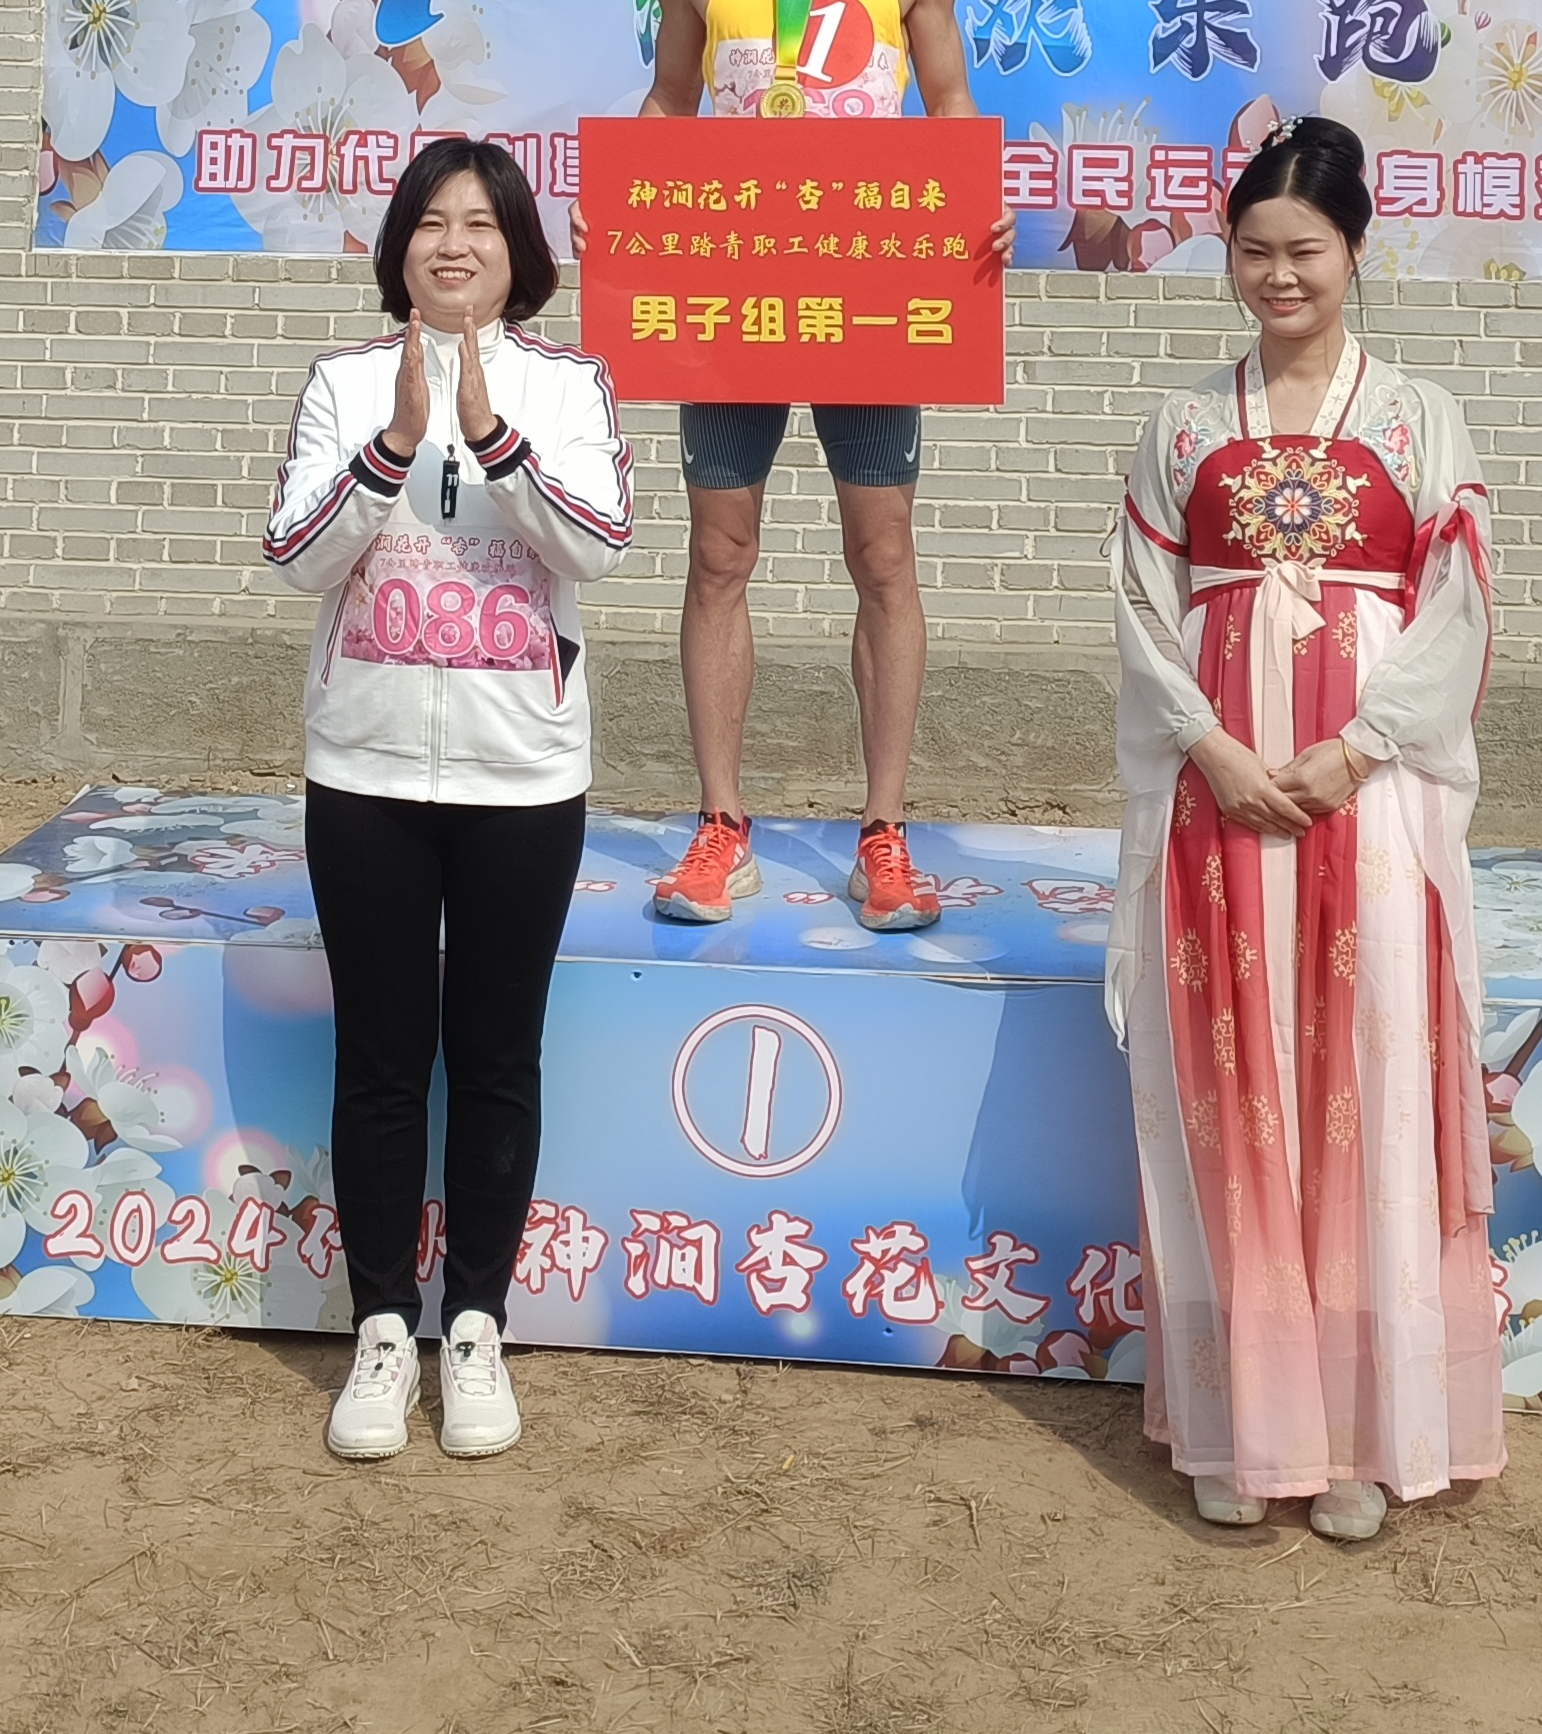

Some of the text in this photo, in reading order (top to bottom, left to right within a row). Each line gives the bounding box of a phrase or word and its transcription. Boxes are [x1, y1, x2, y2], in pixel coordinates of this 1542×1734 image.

[797, 1, 846, 83] 1
[627, 178, 948, 214] 神涧花开“杏”福自来
[606, 229, 970, 261] 7公里踏青职工健康欢乐跑
[631, 294, 955, 346] 男子组第一名
[372, 578, 532, 661] 086
[43, 1189, 1145, 1330] 2024神涧杏花文化
